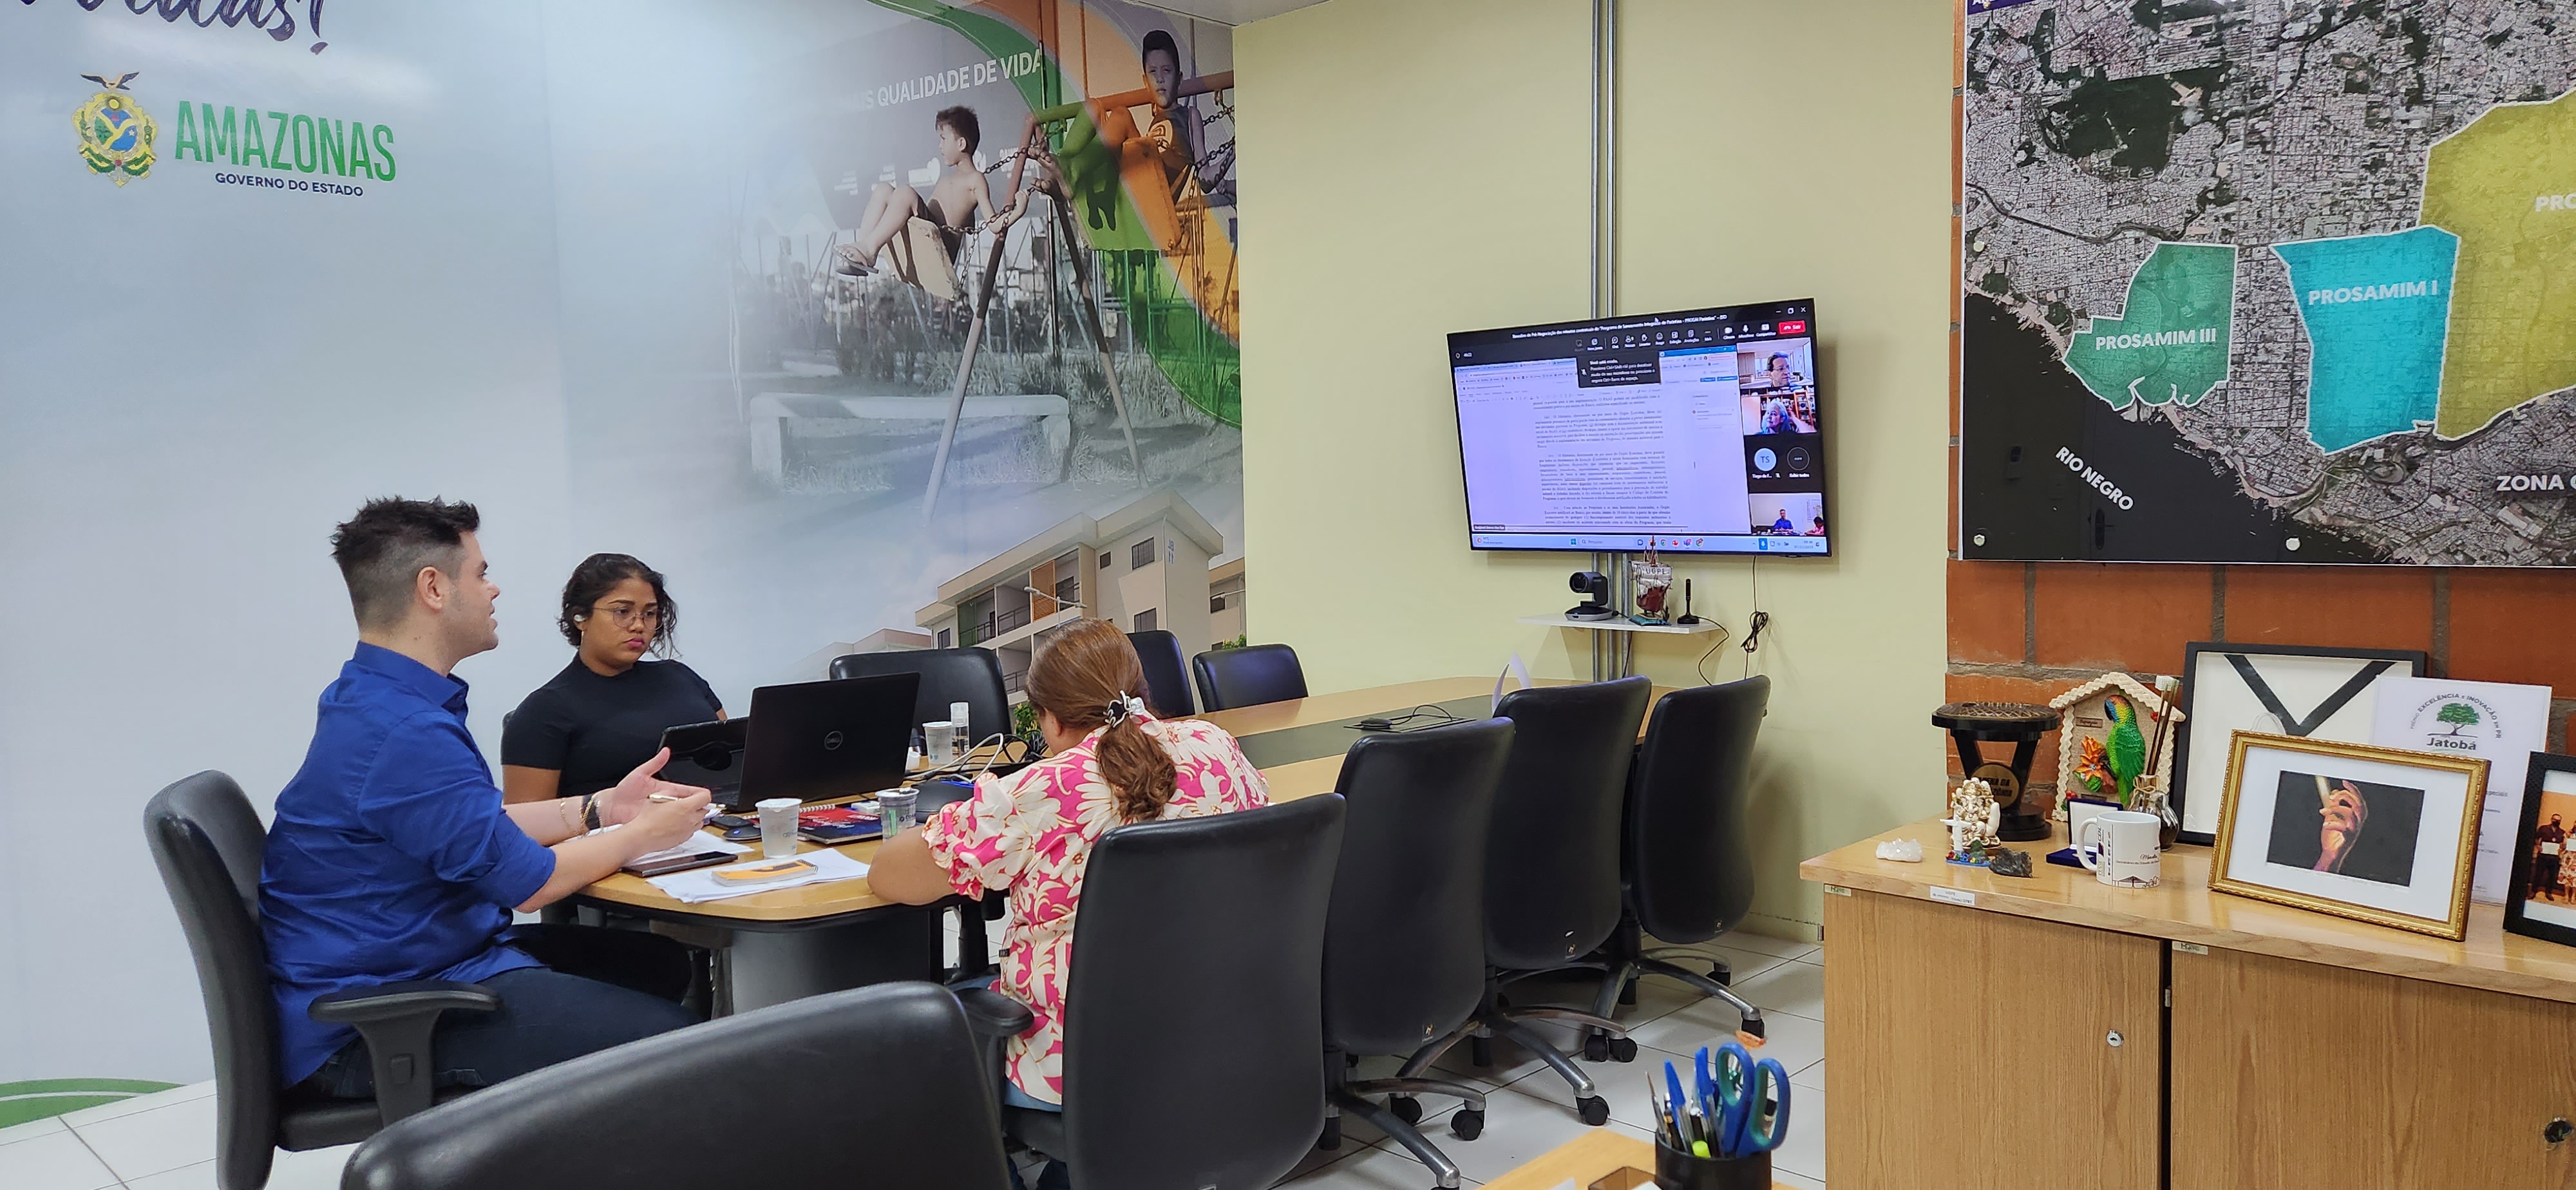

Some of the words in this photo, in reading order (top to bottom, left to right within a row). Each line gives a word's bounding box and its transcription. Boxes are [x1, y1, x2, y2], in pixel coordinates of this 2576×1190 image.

[877, 66, 971, 107] QUALIDADE
[974, 59, 998, 86] DE
[175, 100, 397, 183] AMAZONAS
[214, 172, 285, 189] GOVERNO
[288, 180, 308, 191] DO
[312, 182, 364, 197] ESTADO
[2308, 280, 2427, 306] PROSAMIM
[2432, 279, 2438, 296] I
[2096, 329, 2196, 351] PROSAMIM
[2199, 328, 2217, 343] III
[2055, 446, 2084, 472] RIO
[2080, 465, 2134, 511] NEGRO
[2496, 474, 2565, 491] ZONA
[2417, 693, 2459, 713] EXCELÊNCIA
[2466, 695, 2497, 721] INOVAÇÃO
[2427, 737, 2476, 750] Jatobá
